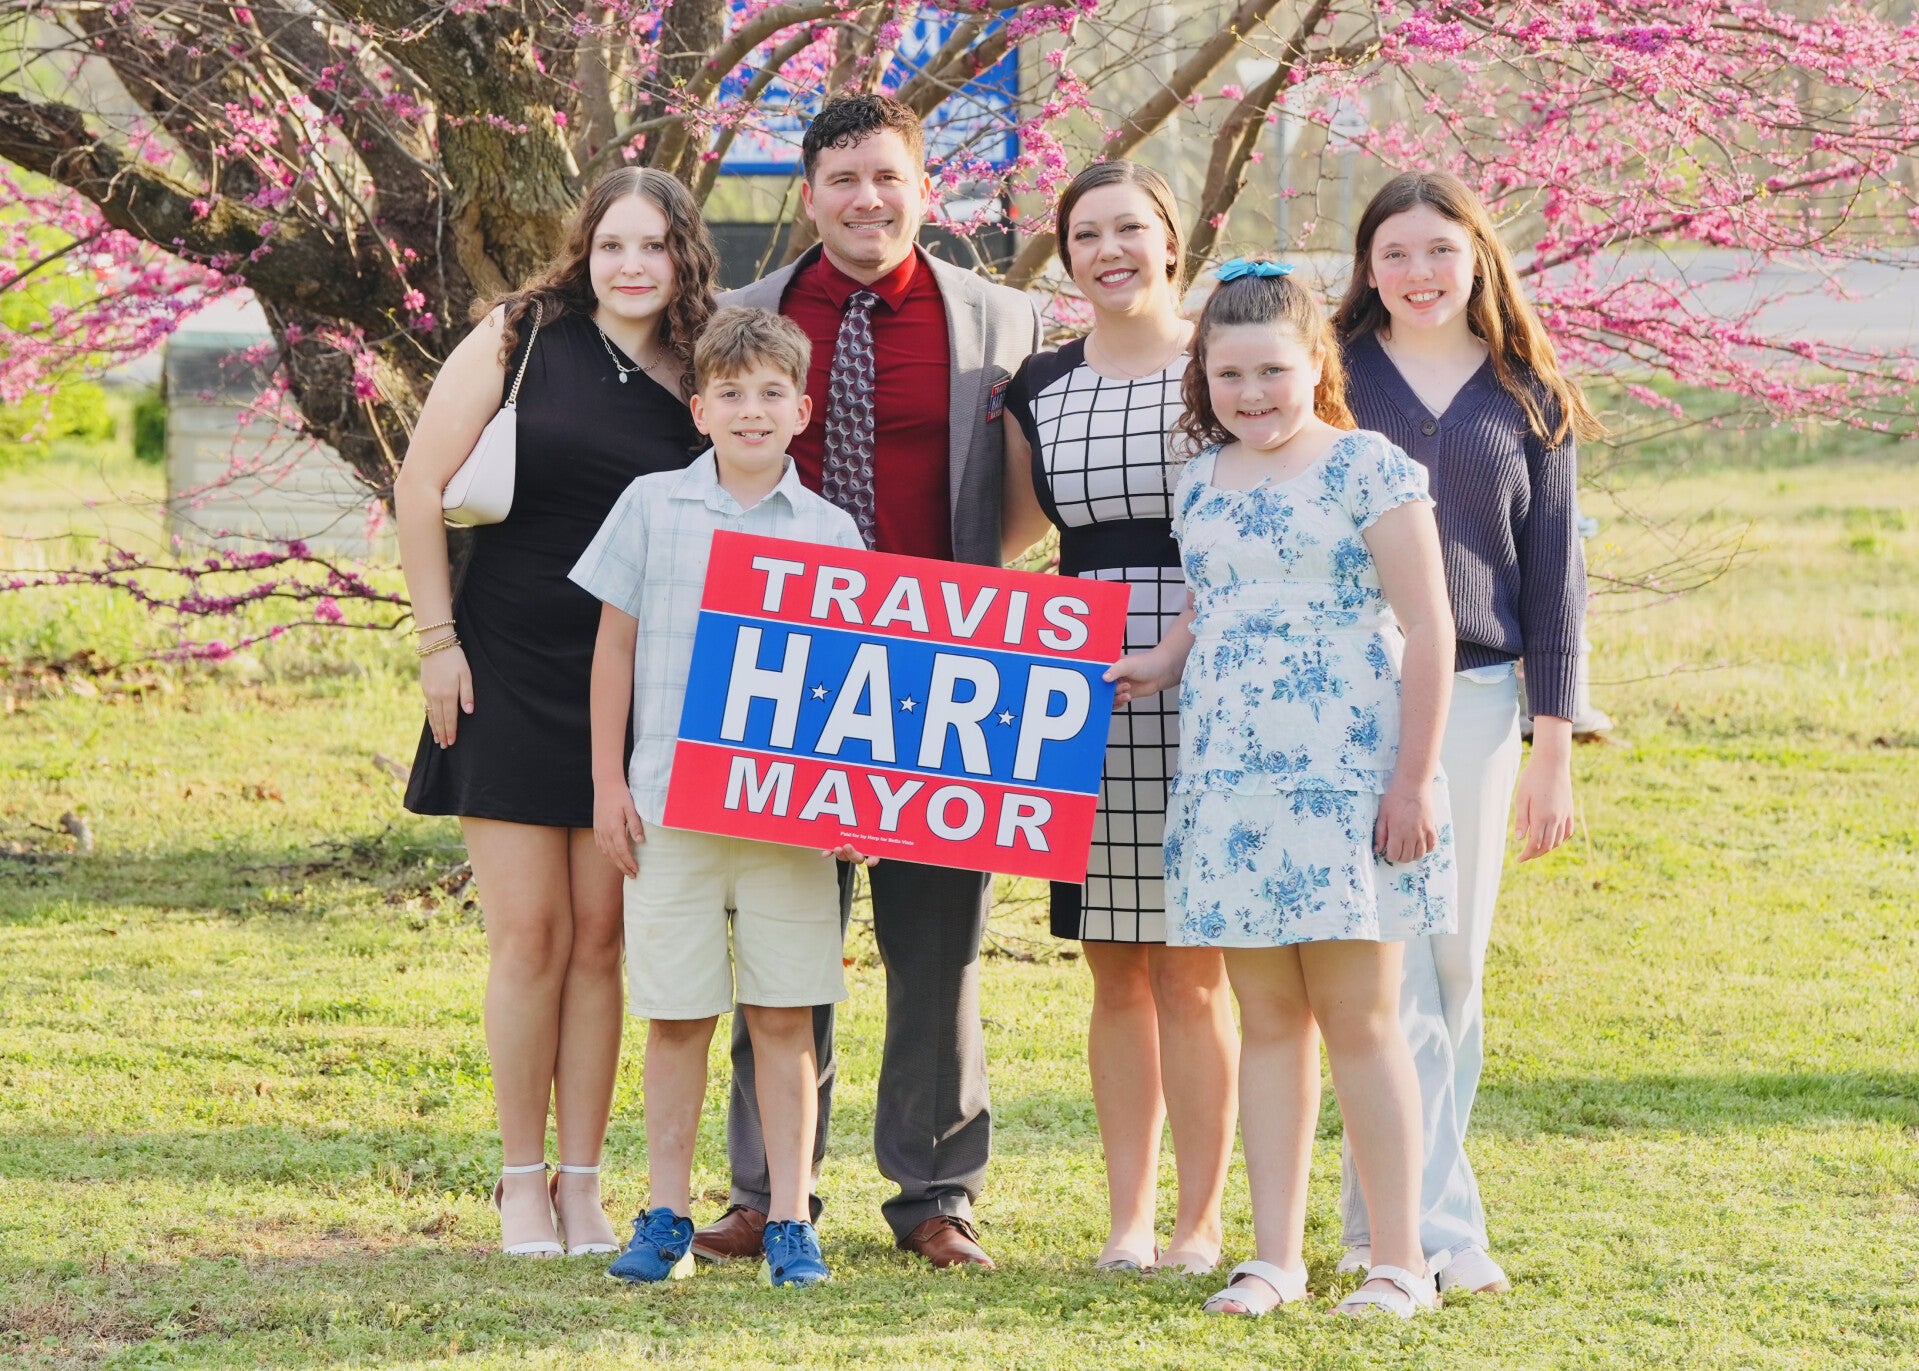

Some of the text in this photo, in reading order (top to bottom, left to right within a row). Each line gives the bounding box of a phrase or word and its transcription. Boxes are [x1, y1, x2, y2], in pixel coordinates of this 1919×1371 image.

[752, 556, 1090, 651] TRAVIS
[719, 625, 1091, 781] HARP
[723, 755, 1053, 852] MAYOR
